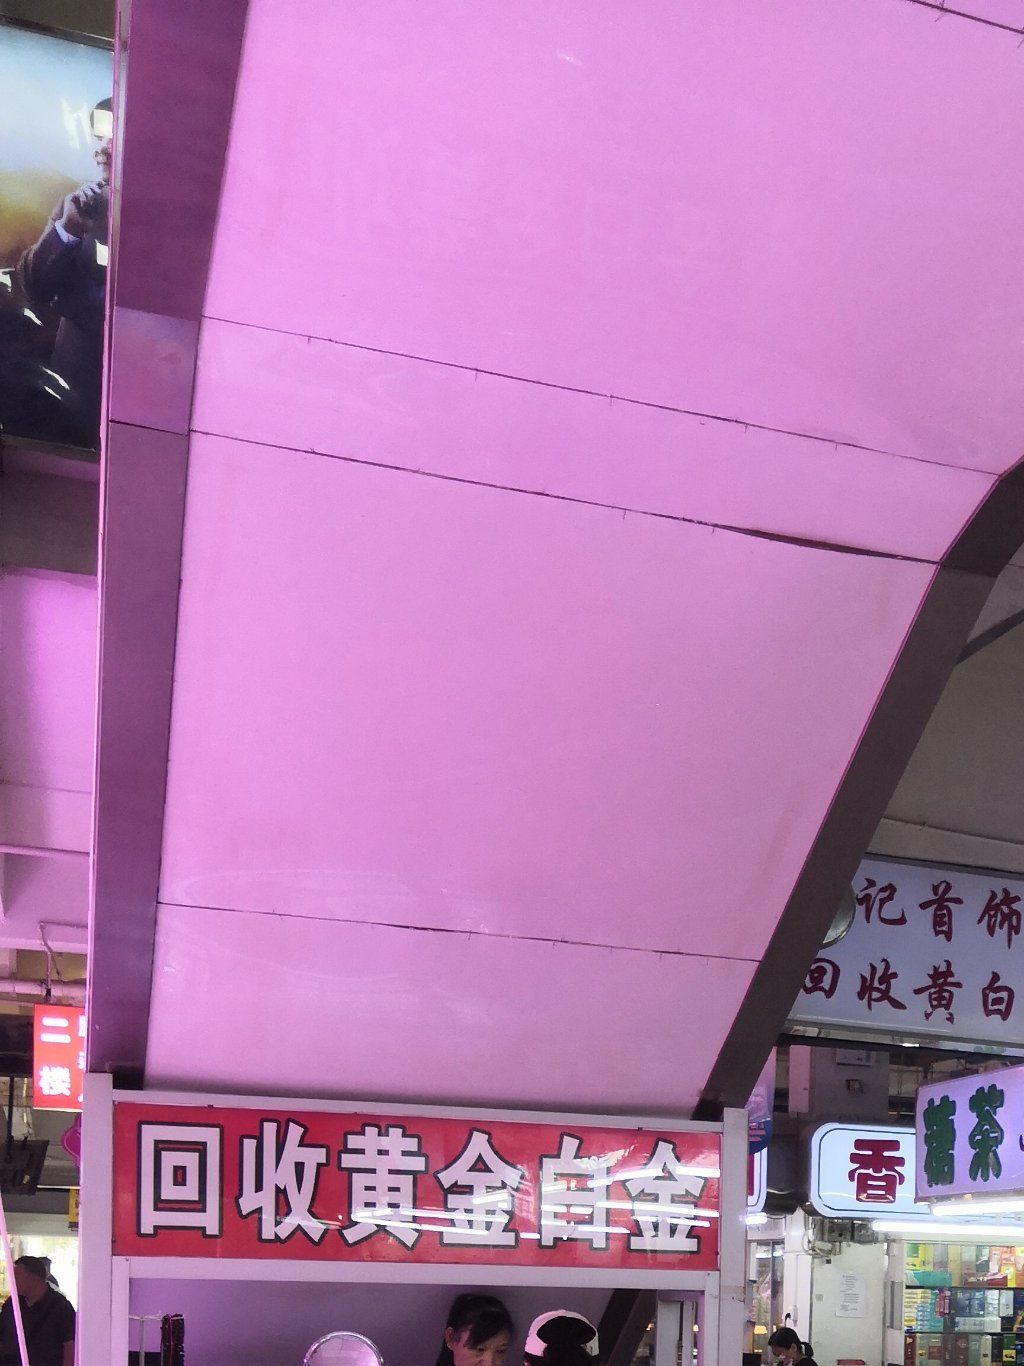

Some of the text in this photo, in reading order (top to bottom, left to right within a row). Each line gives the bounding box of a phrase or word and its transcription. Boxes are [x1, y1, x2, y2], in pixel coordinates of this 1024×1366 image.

[40, 1016, 72, 1096] 二楼
[135, 1118, 708, 1255] 回收黄金白金
[848, 1138, 906, 1204] 香
